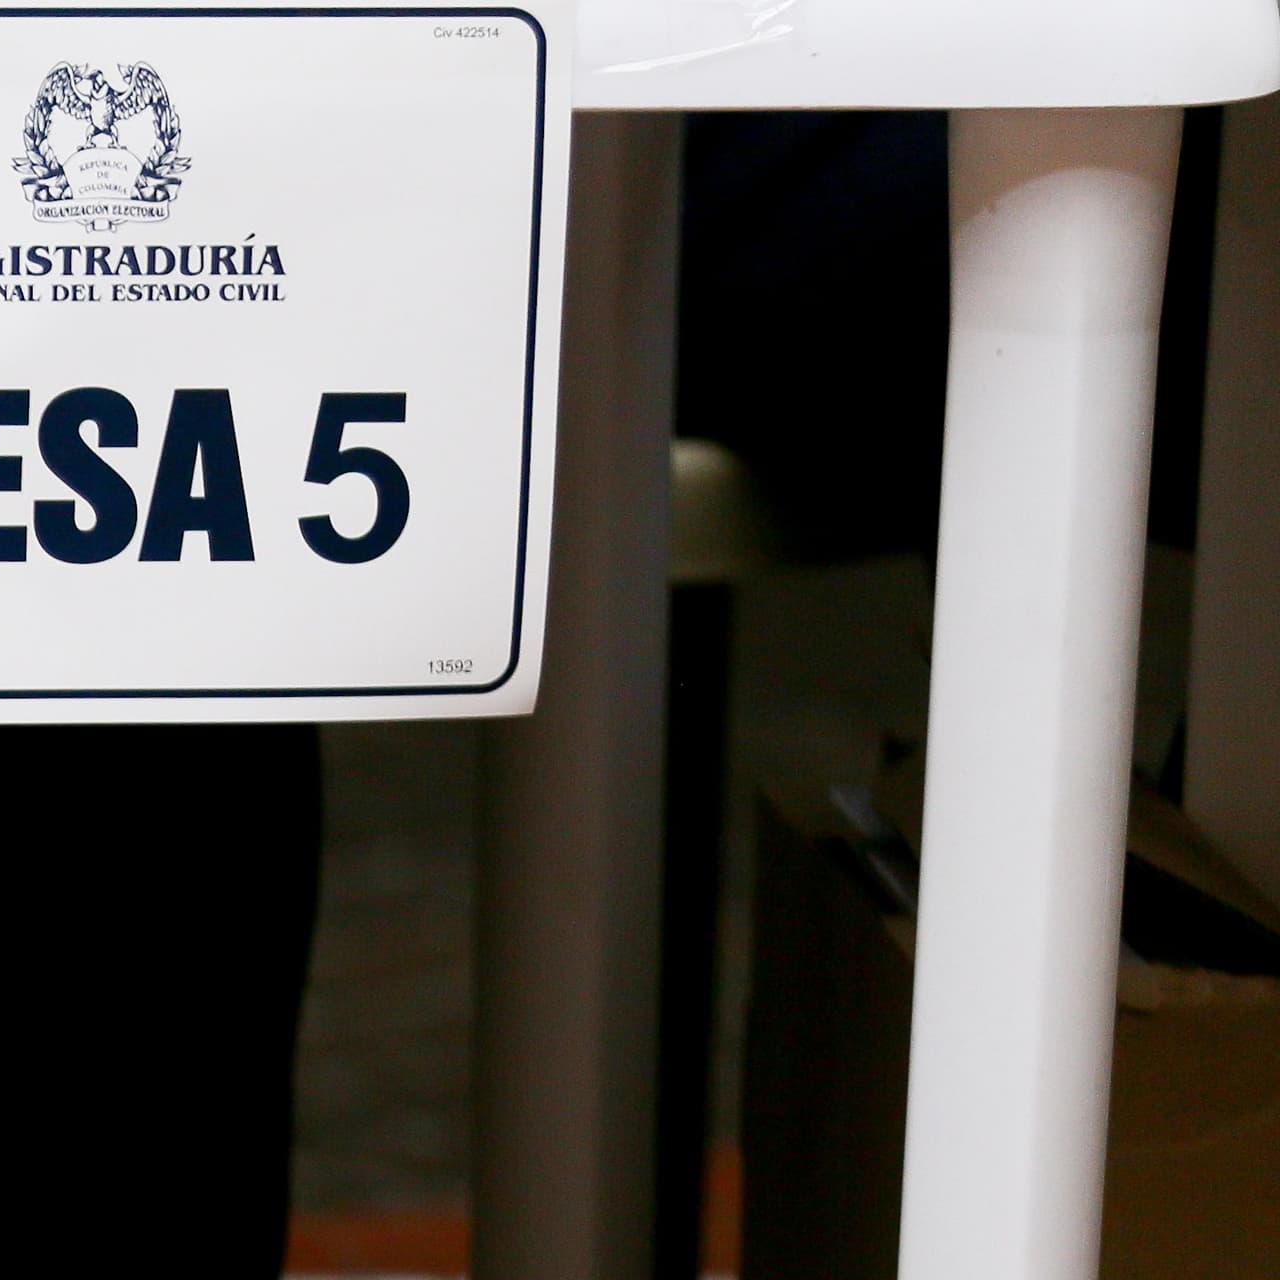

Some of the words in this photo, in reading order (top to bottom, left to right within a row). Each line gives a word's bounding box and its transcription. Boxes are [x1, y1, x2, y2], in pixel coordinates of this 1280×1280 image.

[112, 204, 165, 218] ELECTORAL
[52, 284, 101, 302] DEL
[112, 284, 211, 302] ESTADO
[219, 283, 286, 302] CIVIL
[298, 392, 410, 563] 5
[429, 659, 473, 674] 13592
